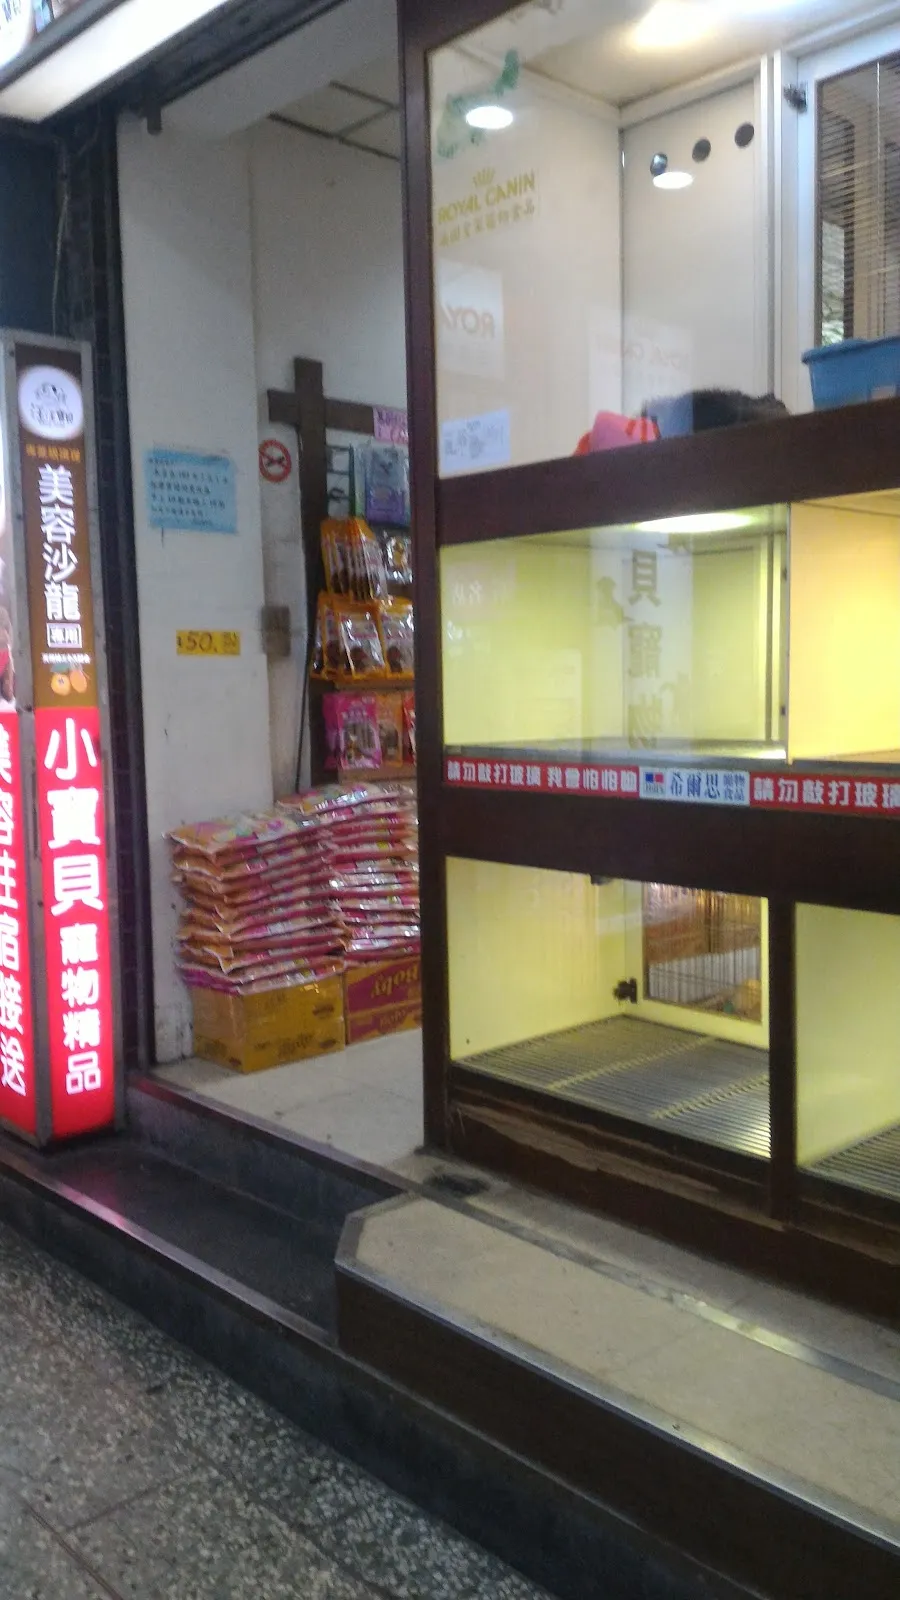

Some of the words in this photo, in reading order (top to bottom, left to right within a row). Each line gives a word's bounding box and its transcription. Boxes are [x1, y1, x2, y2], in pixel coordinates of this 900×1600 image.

[437, 194, 482, 225] ROYAL
[485, 168, 535, 207] CANIN
[37, 463, 81, 621] 美容沙龍
[44, 717, 106, 918] 小寶貝
[447, 759, 541, 787] 請勿敲打玻璃
[670, 771, 720, 799] 希爾思
[59, 922, 102, 1094] 寵物精品
